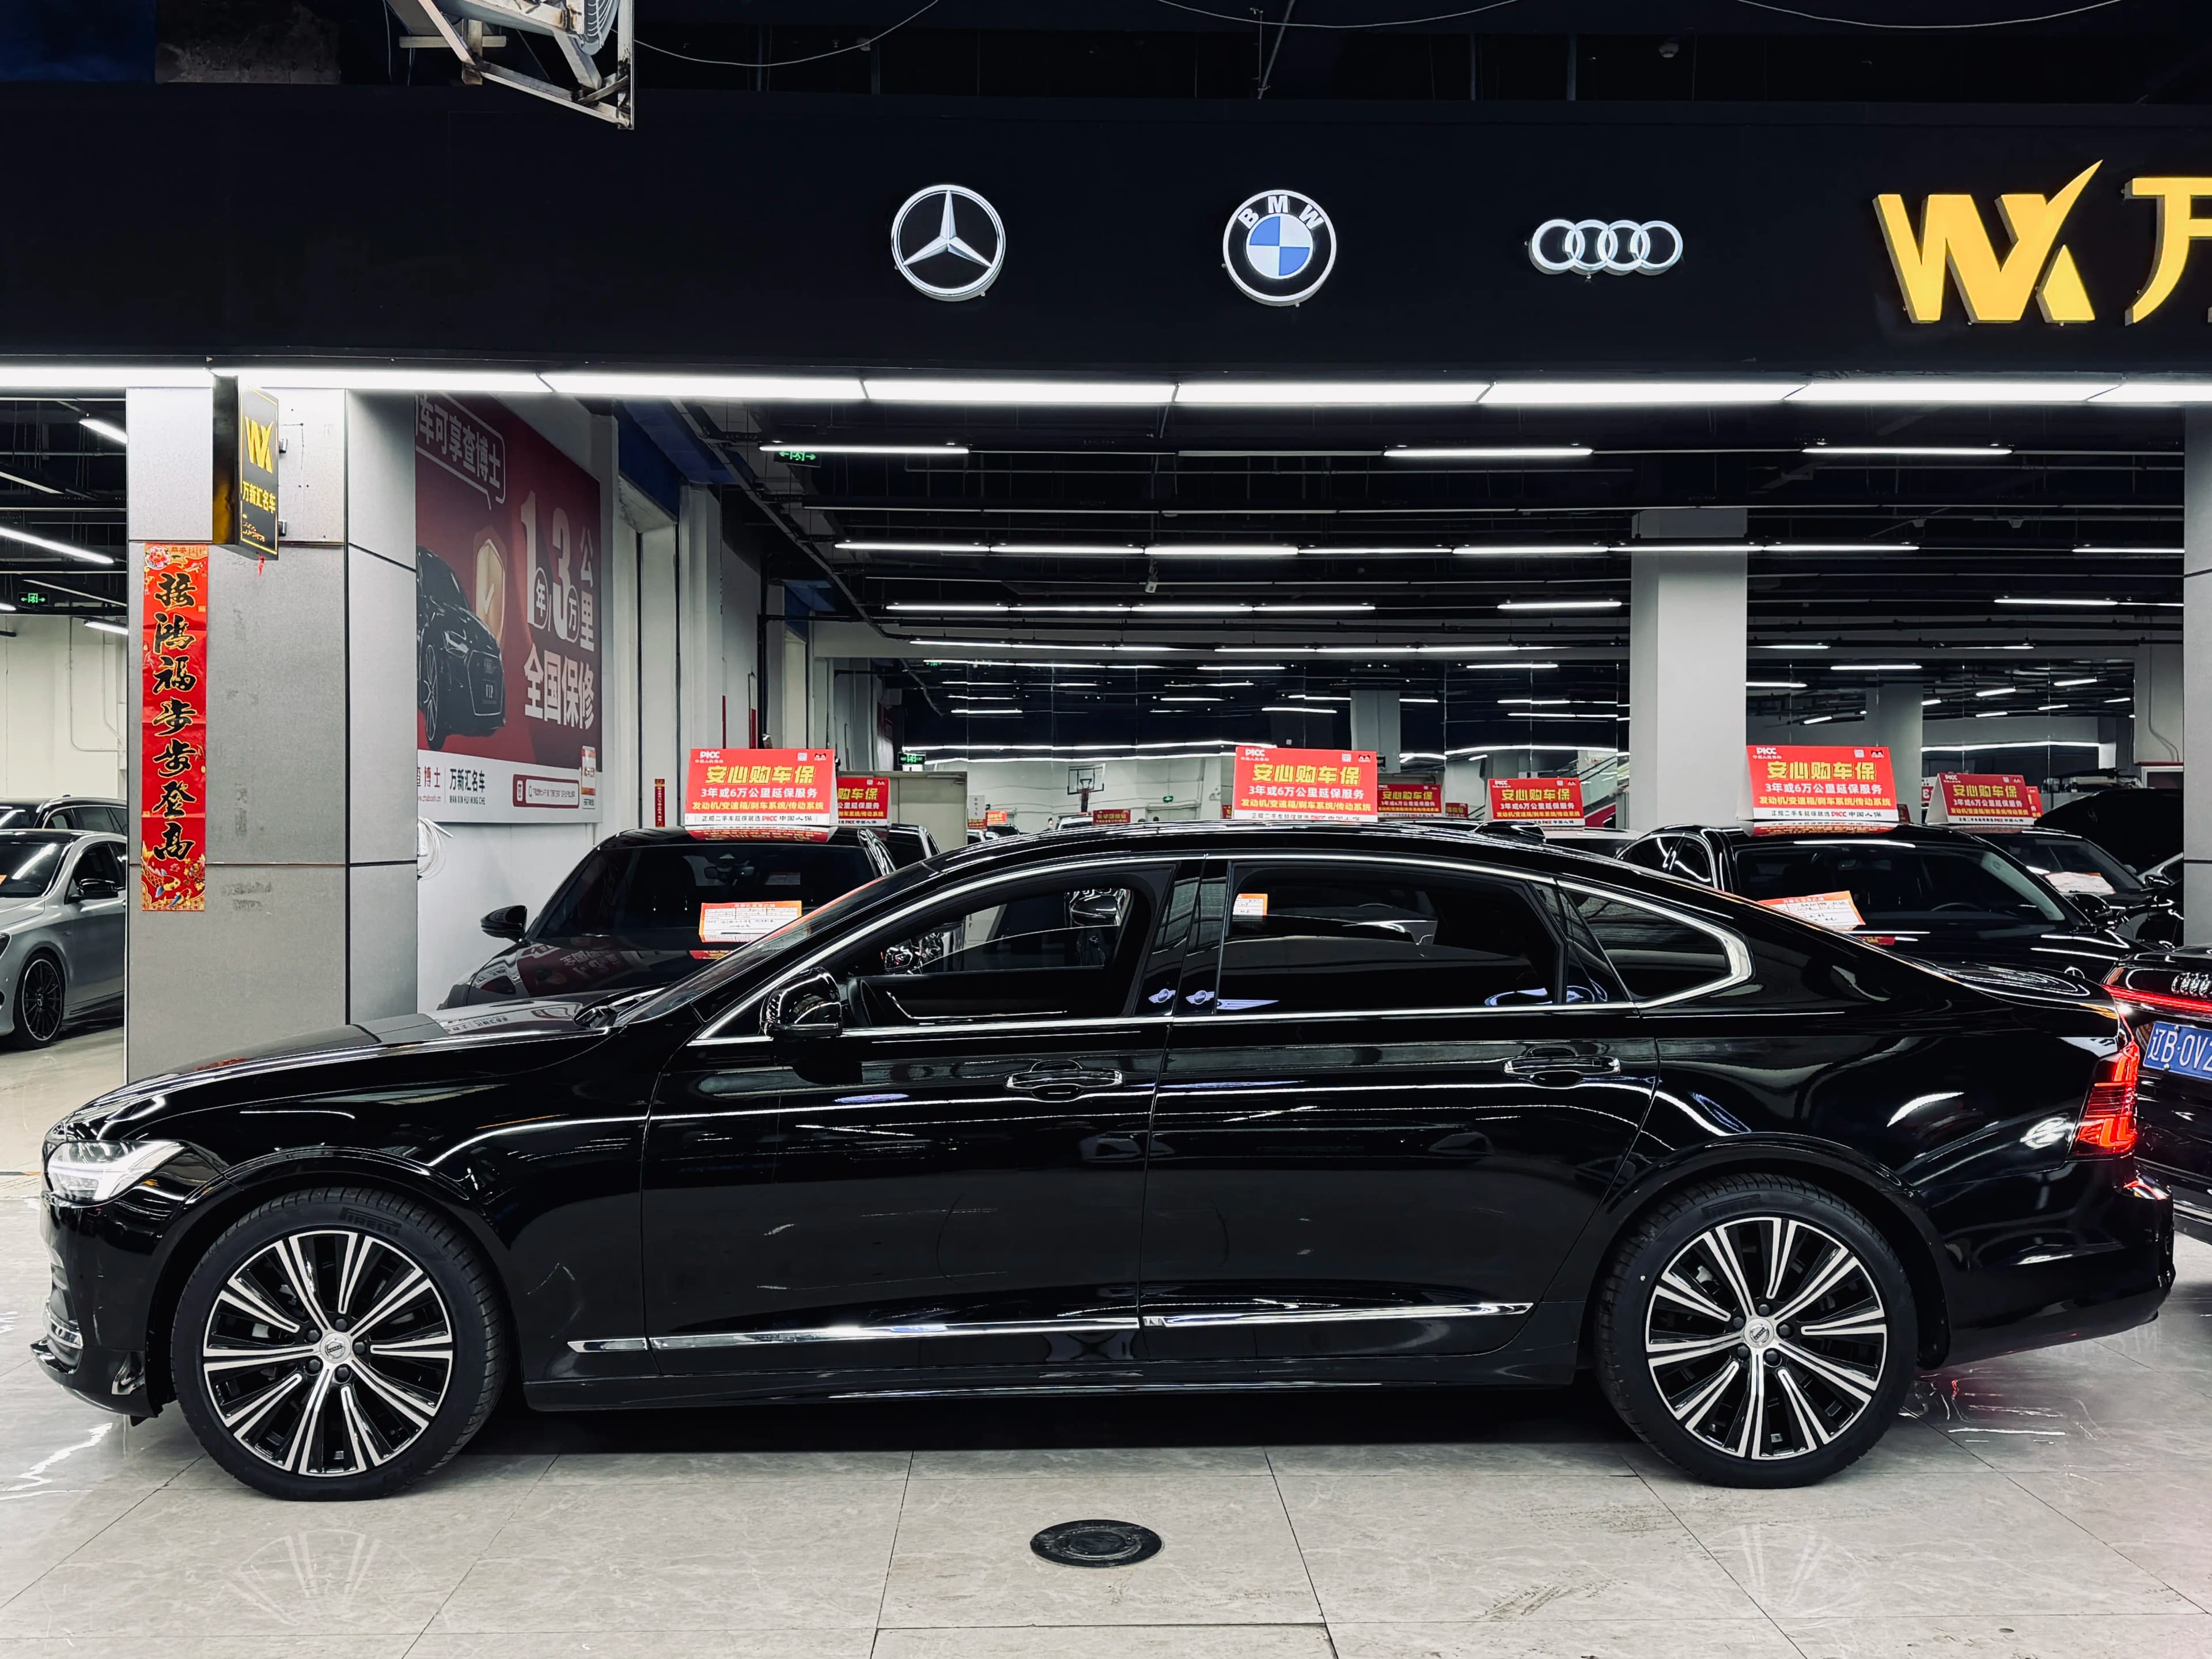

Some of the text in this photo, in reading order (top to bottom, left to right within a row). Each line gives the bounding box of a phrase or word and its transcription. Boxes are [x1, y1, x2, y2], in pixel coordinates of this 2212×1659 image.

[1238, 195, 1325, 230] BMW
[415, 395, 501, 488] 车可享查博士
[242, 480, 276, 513] 万新汇名车
[524, 642, 594, 729] 全国保修
[151, 572, 198, 862] 接鸿福步步登高
[450, 768, 485, 793] 万新汇名车
[705, 765, 816, 785] 安心购车保
[1252, 764, 1360, 785] 安心购车保
[1767, 761, 1876, 781] 安心购车保
[700, 787, 818, 798] 3年或6万公里延保服务
[1249, 786, 1365, 800] 3年或6万公里延保服务
[1502, 789, 1570, 801] 安心购车保
[1765, 783, 1883, 795] 3年或6万公里延保服务
[1953, 785, 2017, 798] 安心购车保
[692, 801, 824, 810] 发动机/变速箱/刹车系统/传动系统
